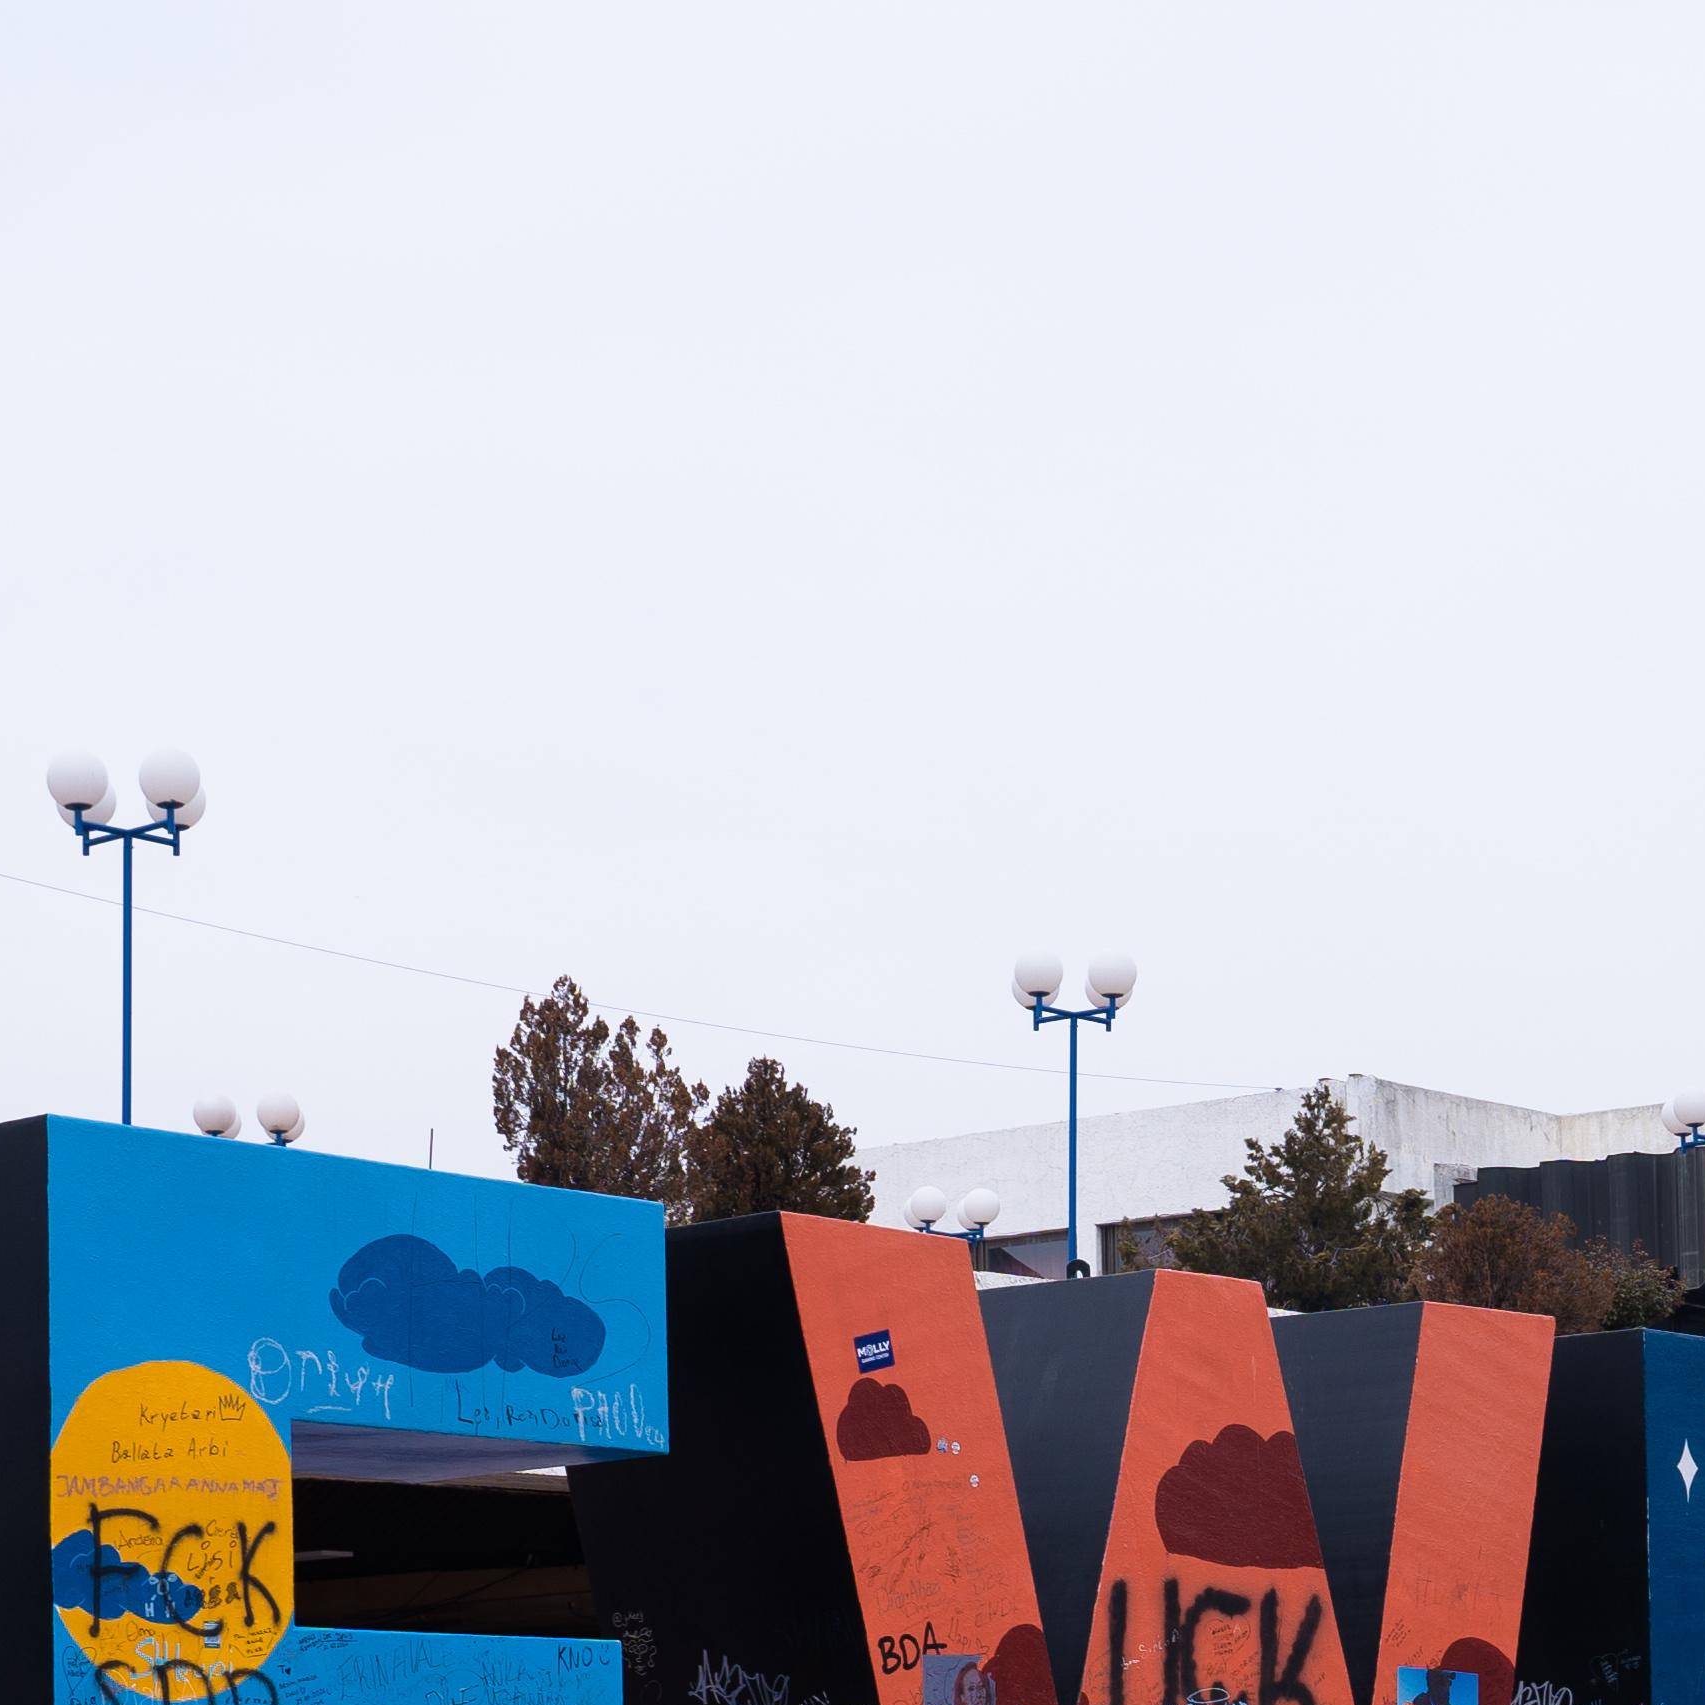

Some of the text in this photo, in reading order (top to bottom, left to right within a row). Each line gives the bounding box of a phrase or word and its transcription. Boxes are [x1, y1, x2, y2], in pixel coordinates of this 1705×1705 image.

[857, 1340, 890, 1358] MOLLY
[187, 1437, 229, 1458] Arbi
[87, 1501, 282, 1638] FCK
[877, 1621, 947, 1675] BDA
